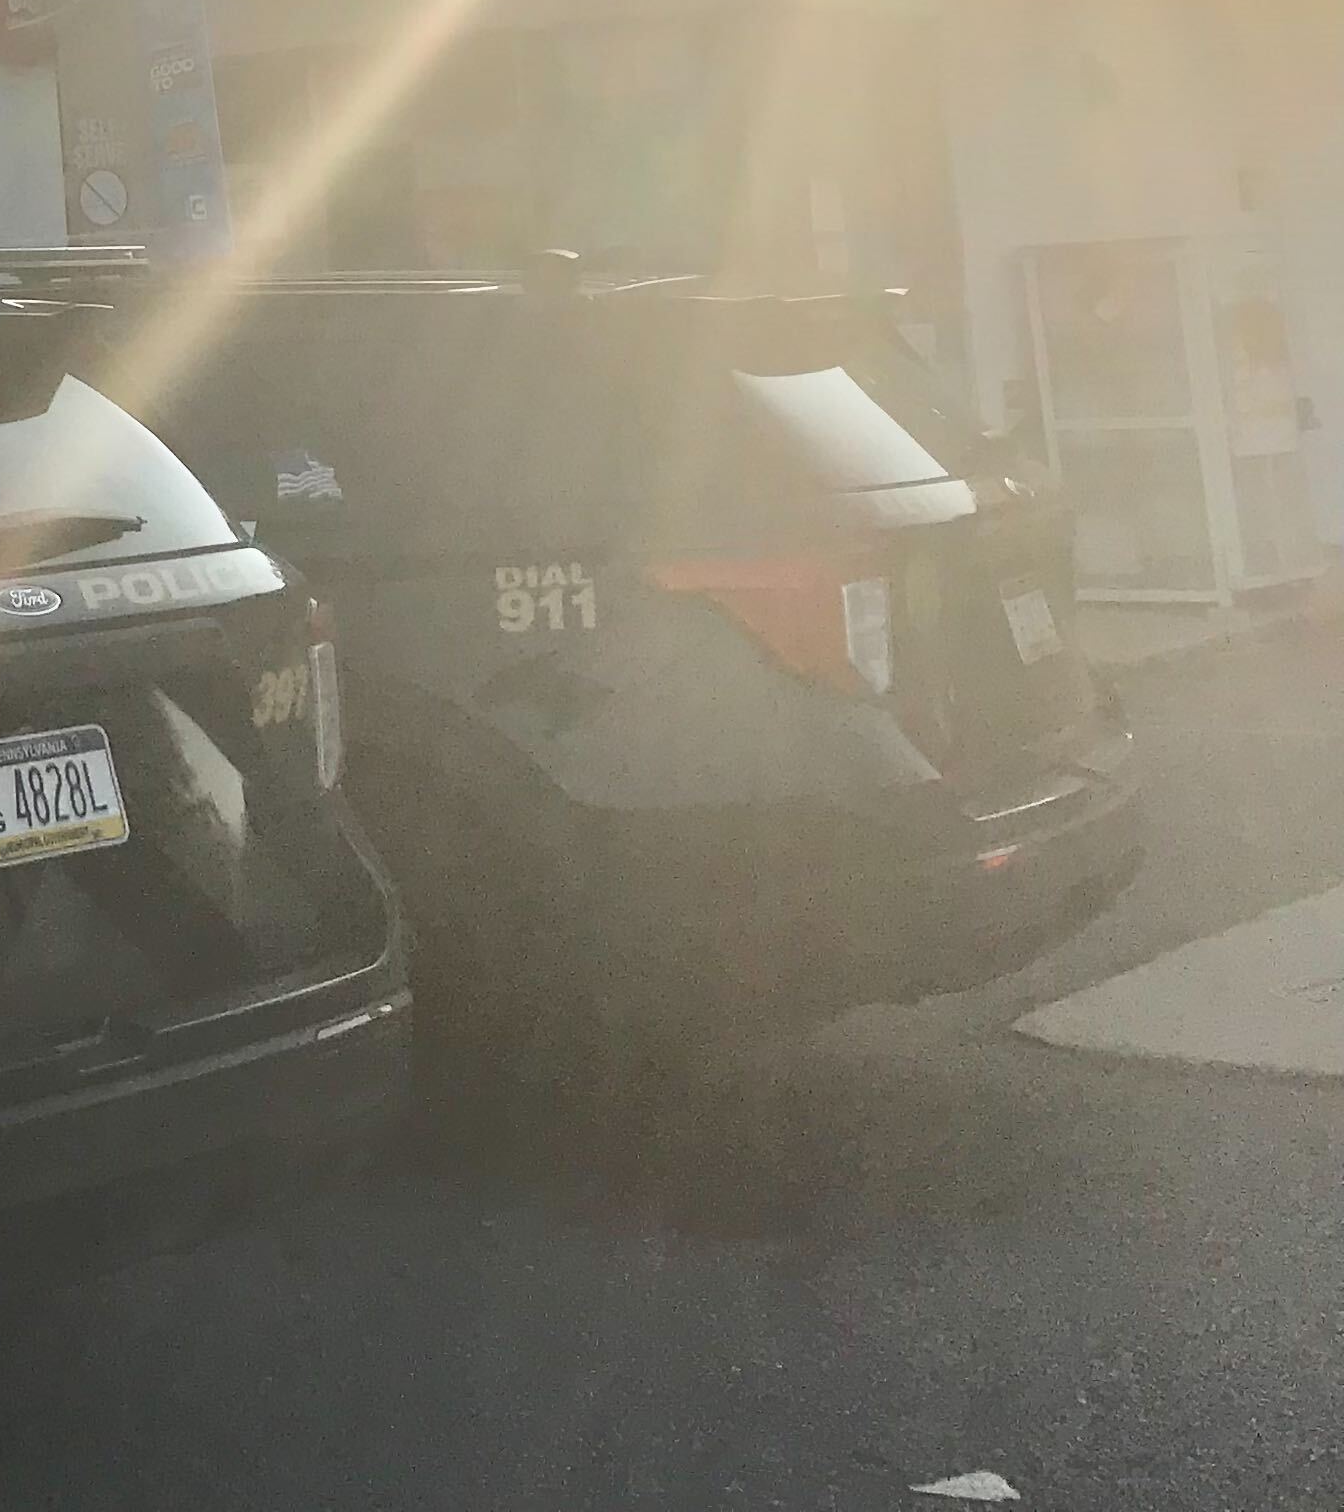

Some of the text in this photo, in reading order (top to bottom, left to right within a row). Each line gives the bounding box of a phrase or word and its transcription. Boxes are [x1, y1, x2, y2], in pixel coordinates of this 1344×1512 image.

[150, 58, 194, 80] GOOD
[78, 558, 248, 609] POLIC
[496, 562, 593, 589] DIAL
[9, 589, 49, 608] Ford
[497, 587, 596, 632] 911
[14, 760, 108, 828] 4828L
